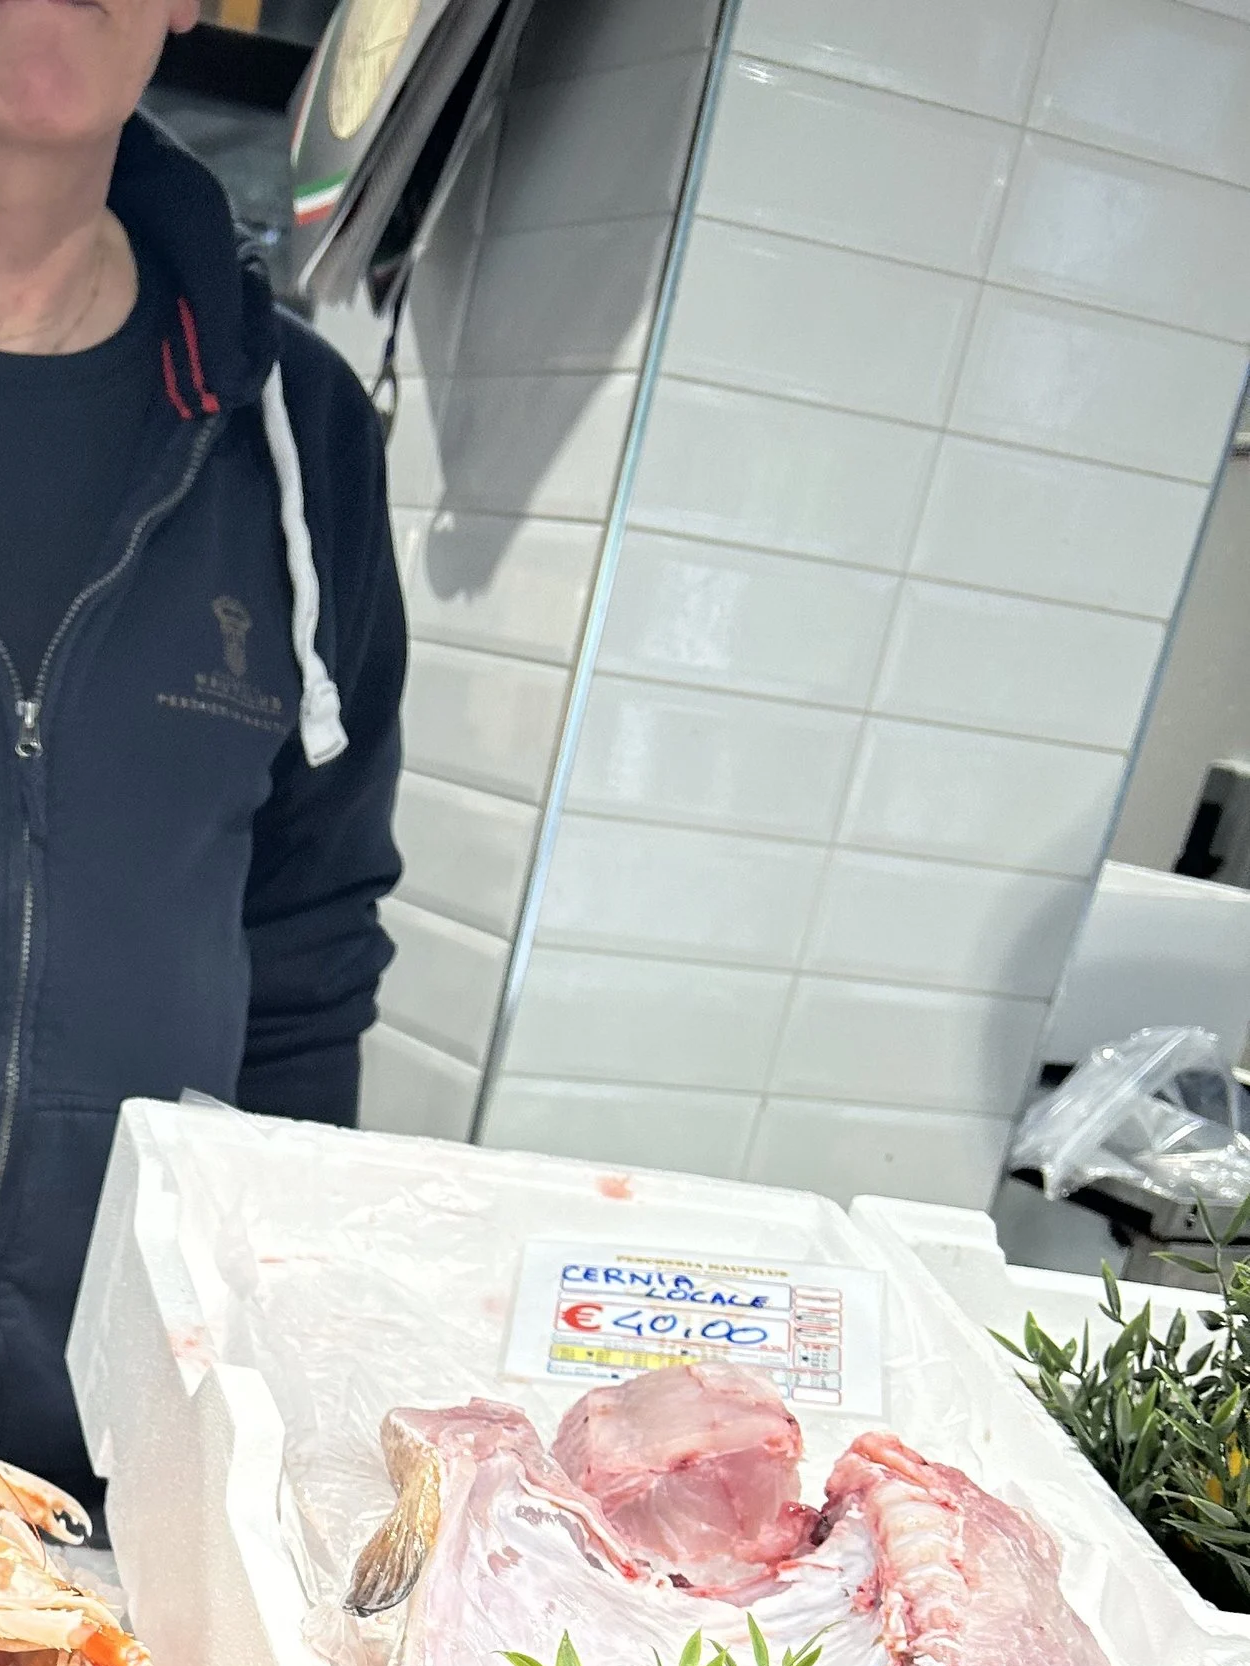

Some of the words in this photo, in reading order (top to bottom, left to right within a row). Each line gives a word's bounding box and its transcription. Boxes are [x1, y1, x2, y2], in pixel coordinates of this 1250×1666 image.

[561, 1265, 695, 1290] CERNIA
[645, 1287, 770, 1309] LOCALE
[561, 1302, 604, 1332] €
